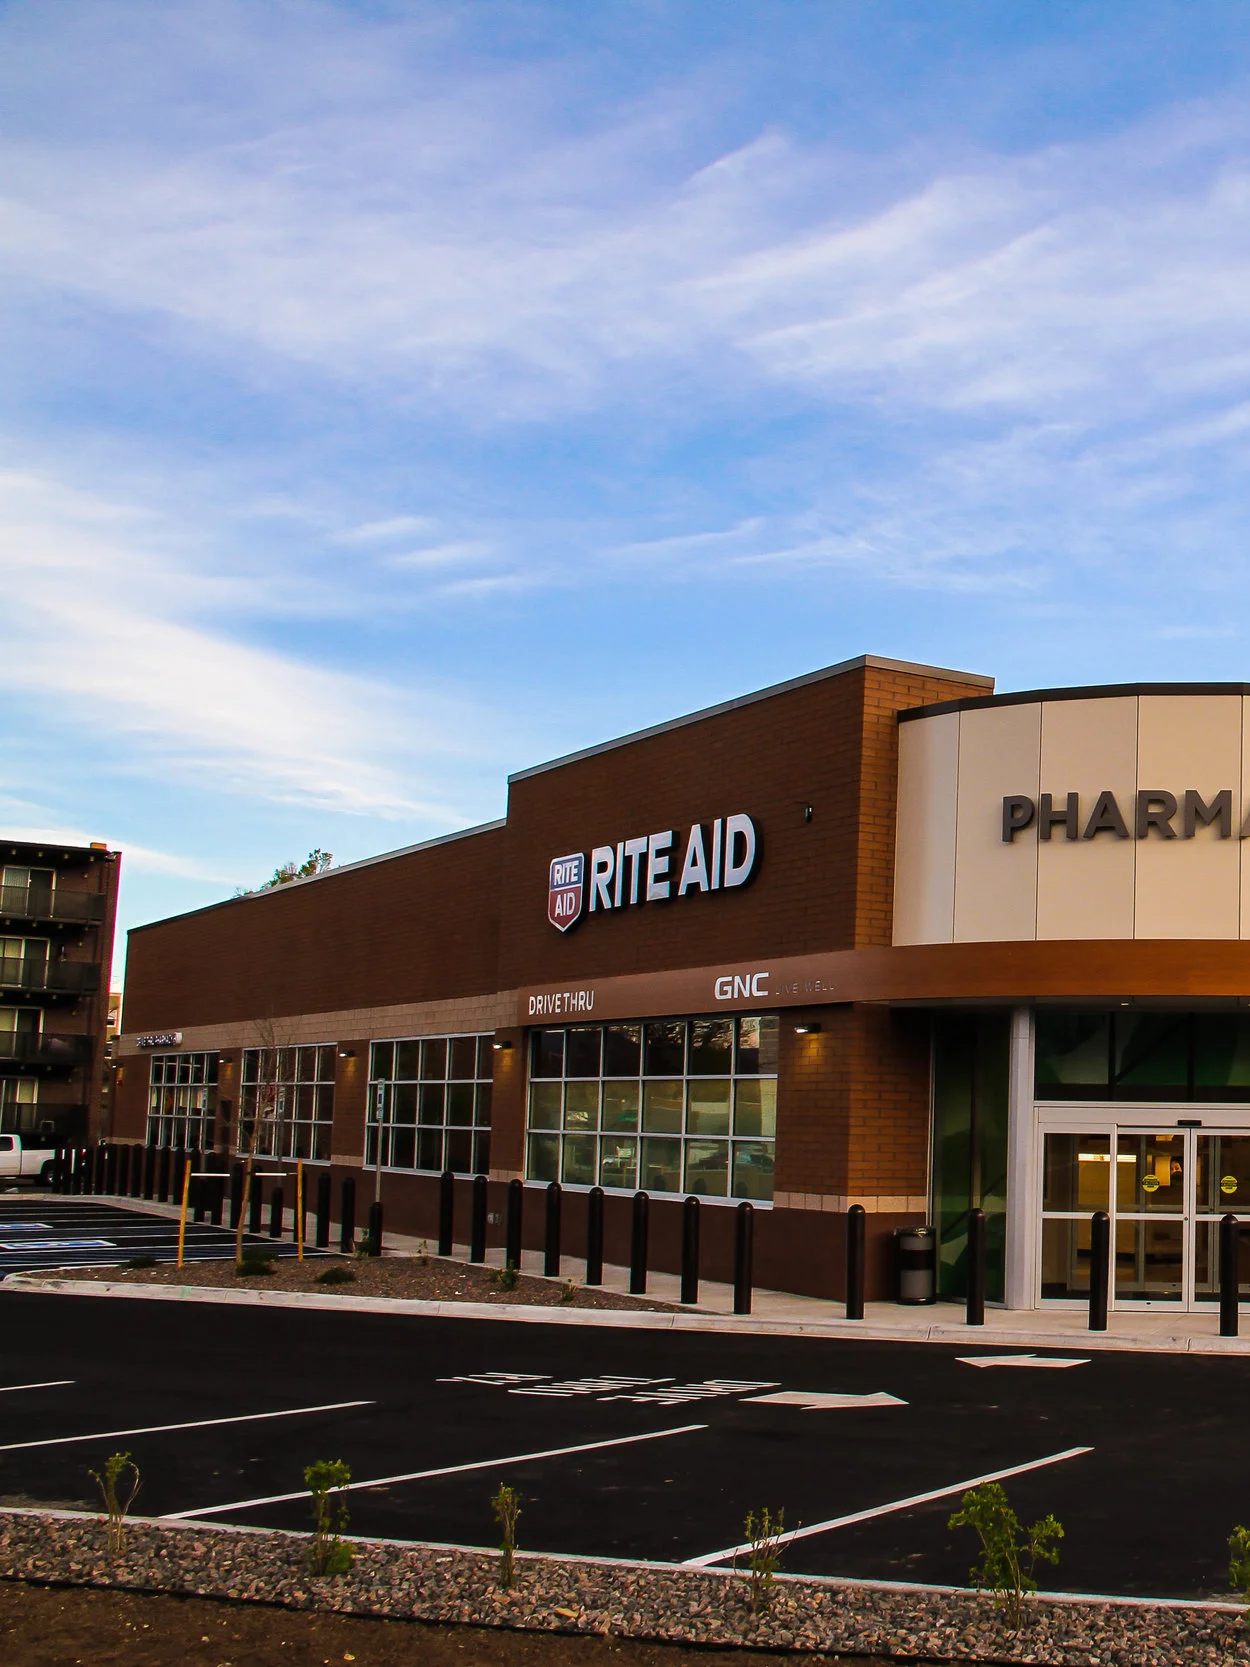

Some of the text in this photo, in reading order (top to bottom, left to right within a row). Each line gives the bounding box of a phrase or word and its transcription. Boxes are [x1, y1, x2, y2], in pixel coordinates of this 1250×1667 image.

[554, 860, 579, 885] RITE
[589, 813, 756, 912] RITE AID
[555, 892, 576, 917] AID
[714, 972, 770, 1000] GNC
[528, 990, 595, 1015] DRIVE THRU
[506, 1375, 676, 1397] THRU
[596, 1379, 782, 1405] DRIVE
